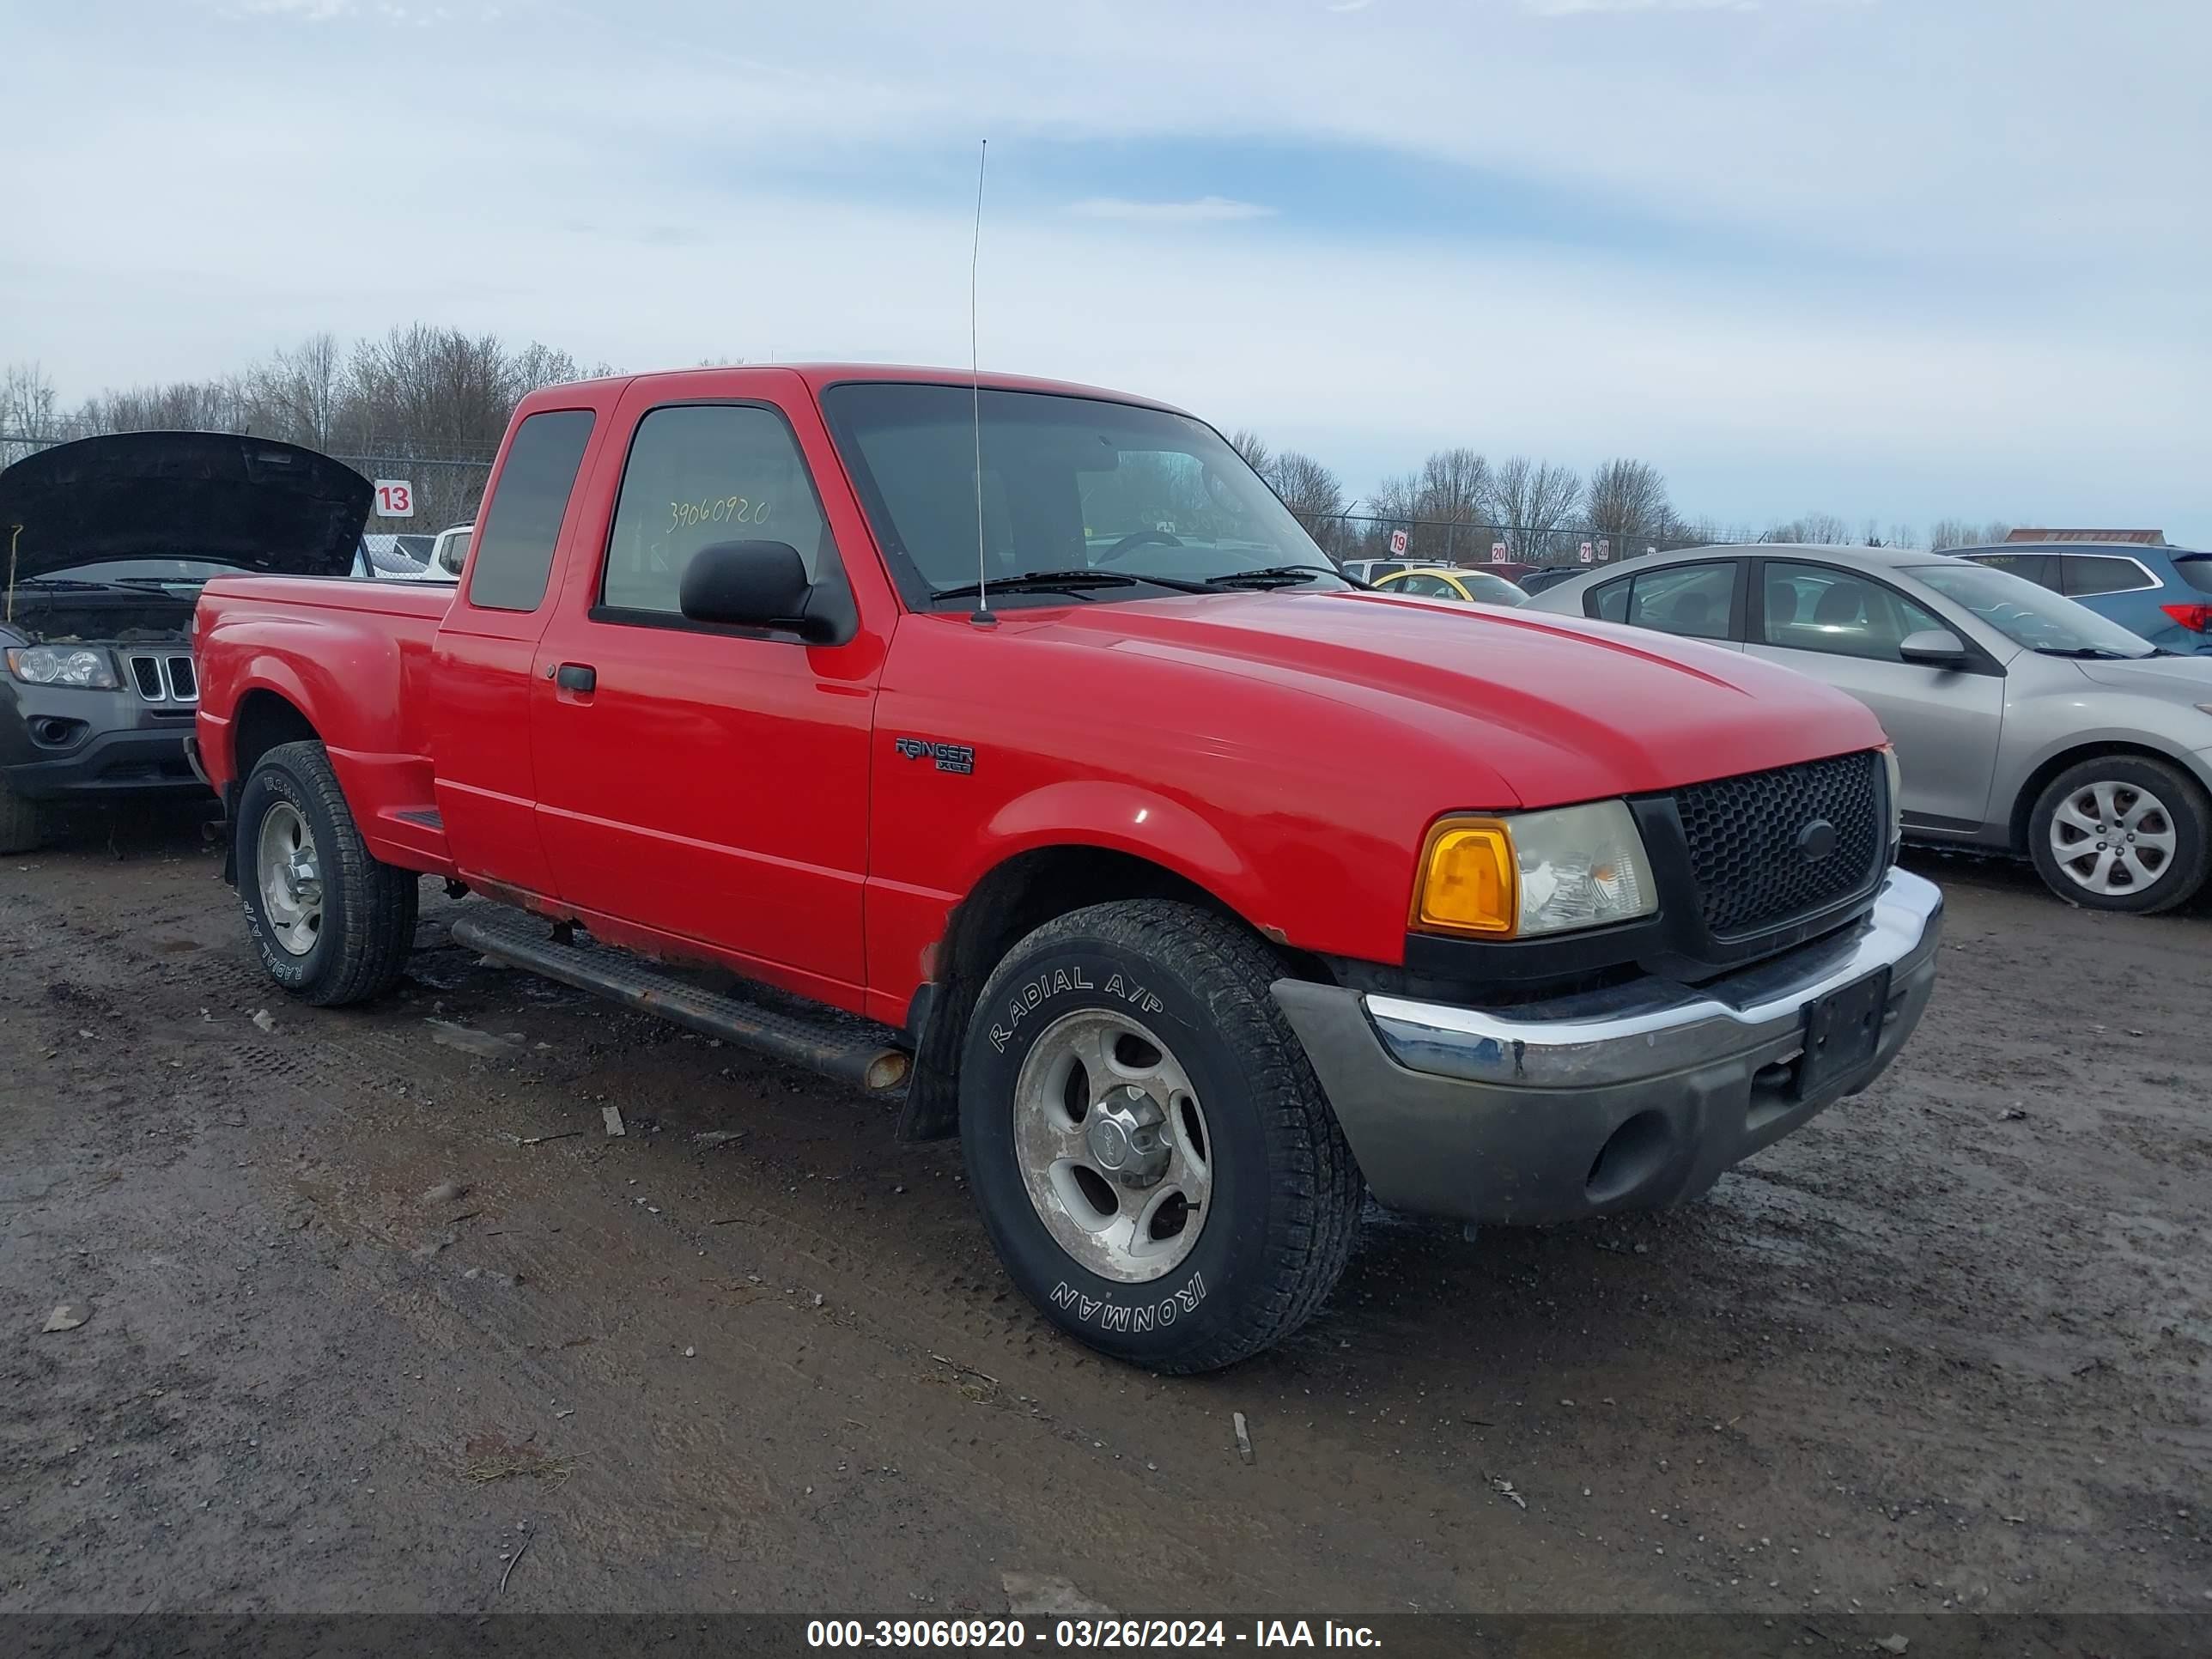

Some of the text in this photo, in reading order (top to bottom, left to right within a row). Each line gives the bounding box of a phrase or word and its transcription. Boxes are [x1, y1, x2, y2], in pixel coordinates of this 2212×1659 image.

[379, 487, 410, 511] 13
[666, 496, 771, 534] 39060920
[1393, 534, 1406, 551] 19
[1493, 547, 1504, 560] 20
[1582, 545, 1591, 560] 21
[1599, 544, 1608, 556] 20
[896, 738, 973, 763] RANGER
[988, 966, 1164, 1054] RADIAL A/P
[1049, 1271, 1206, 1333] IRONMAN
